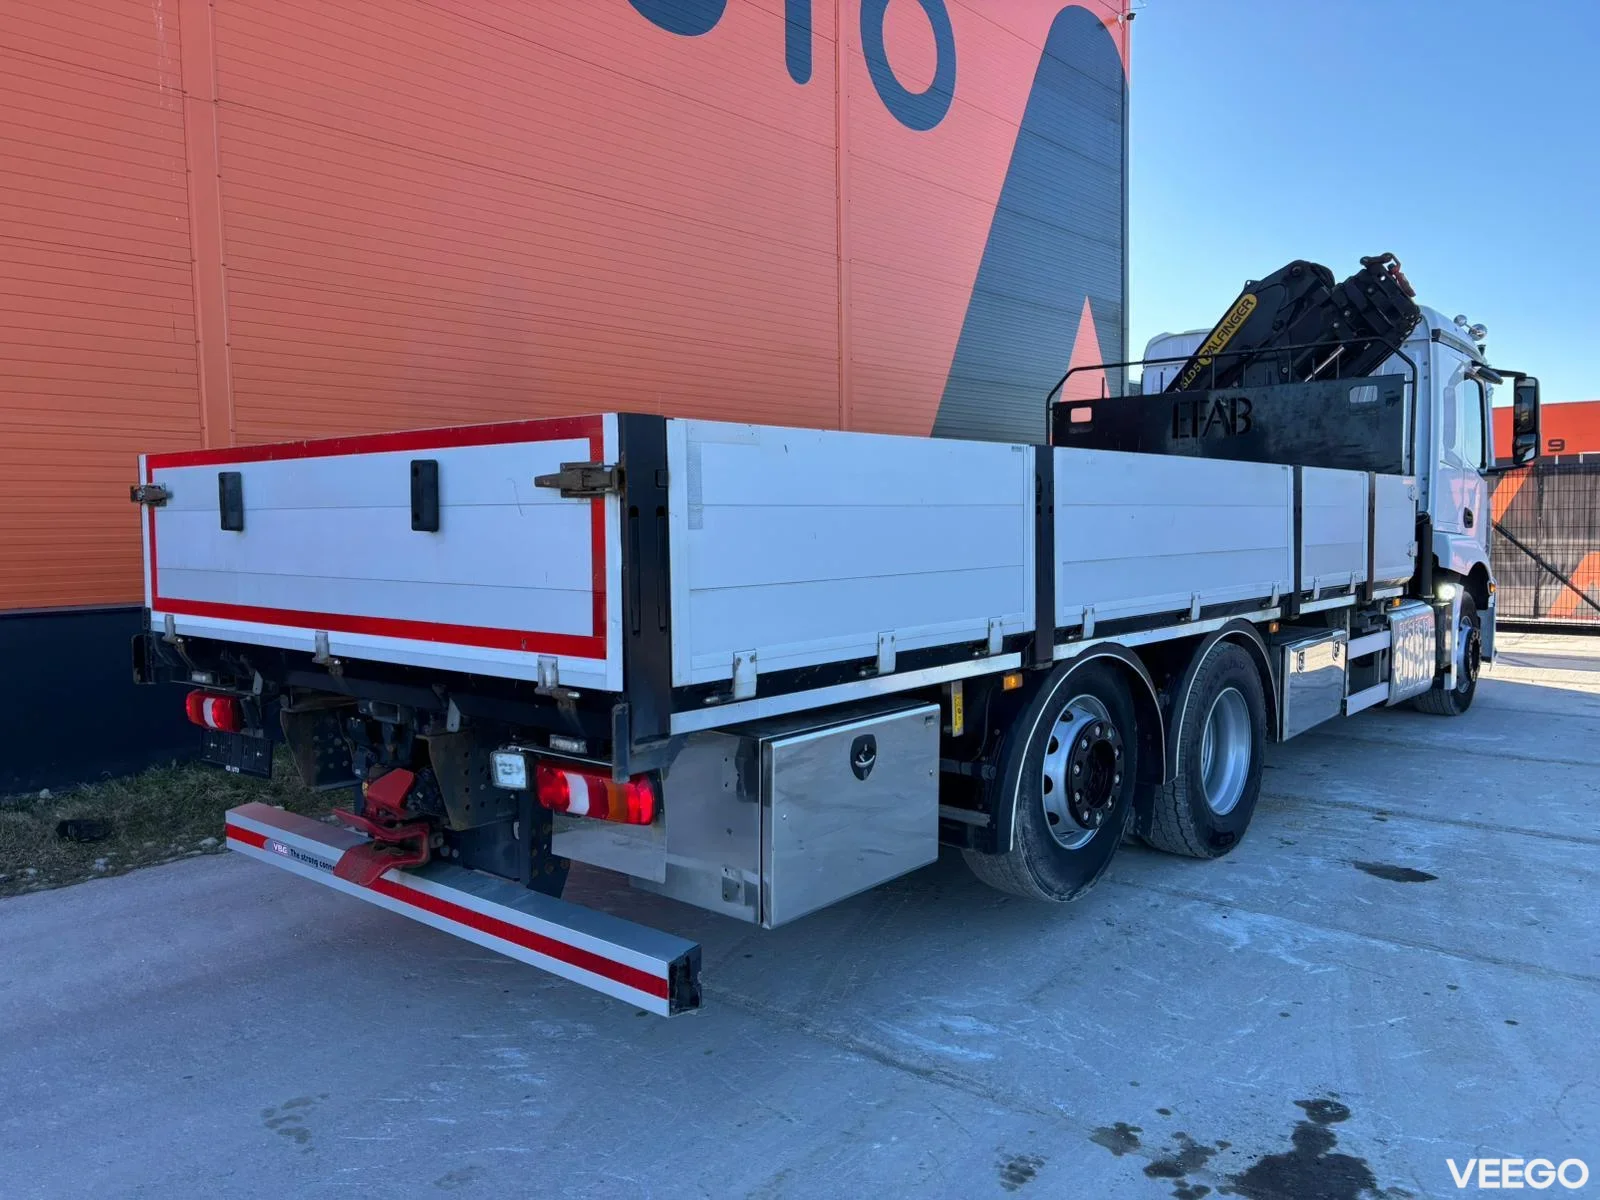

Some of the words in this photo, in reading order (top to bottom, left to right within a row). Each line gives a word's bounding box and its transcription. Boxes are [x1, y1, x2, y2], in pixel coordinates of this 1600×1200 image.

[272, 841, 288, 855] VBG
[290, 848, 300, 859] The
[300, 853, 319, 868] strong
